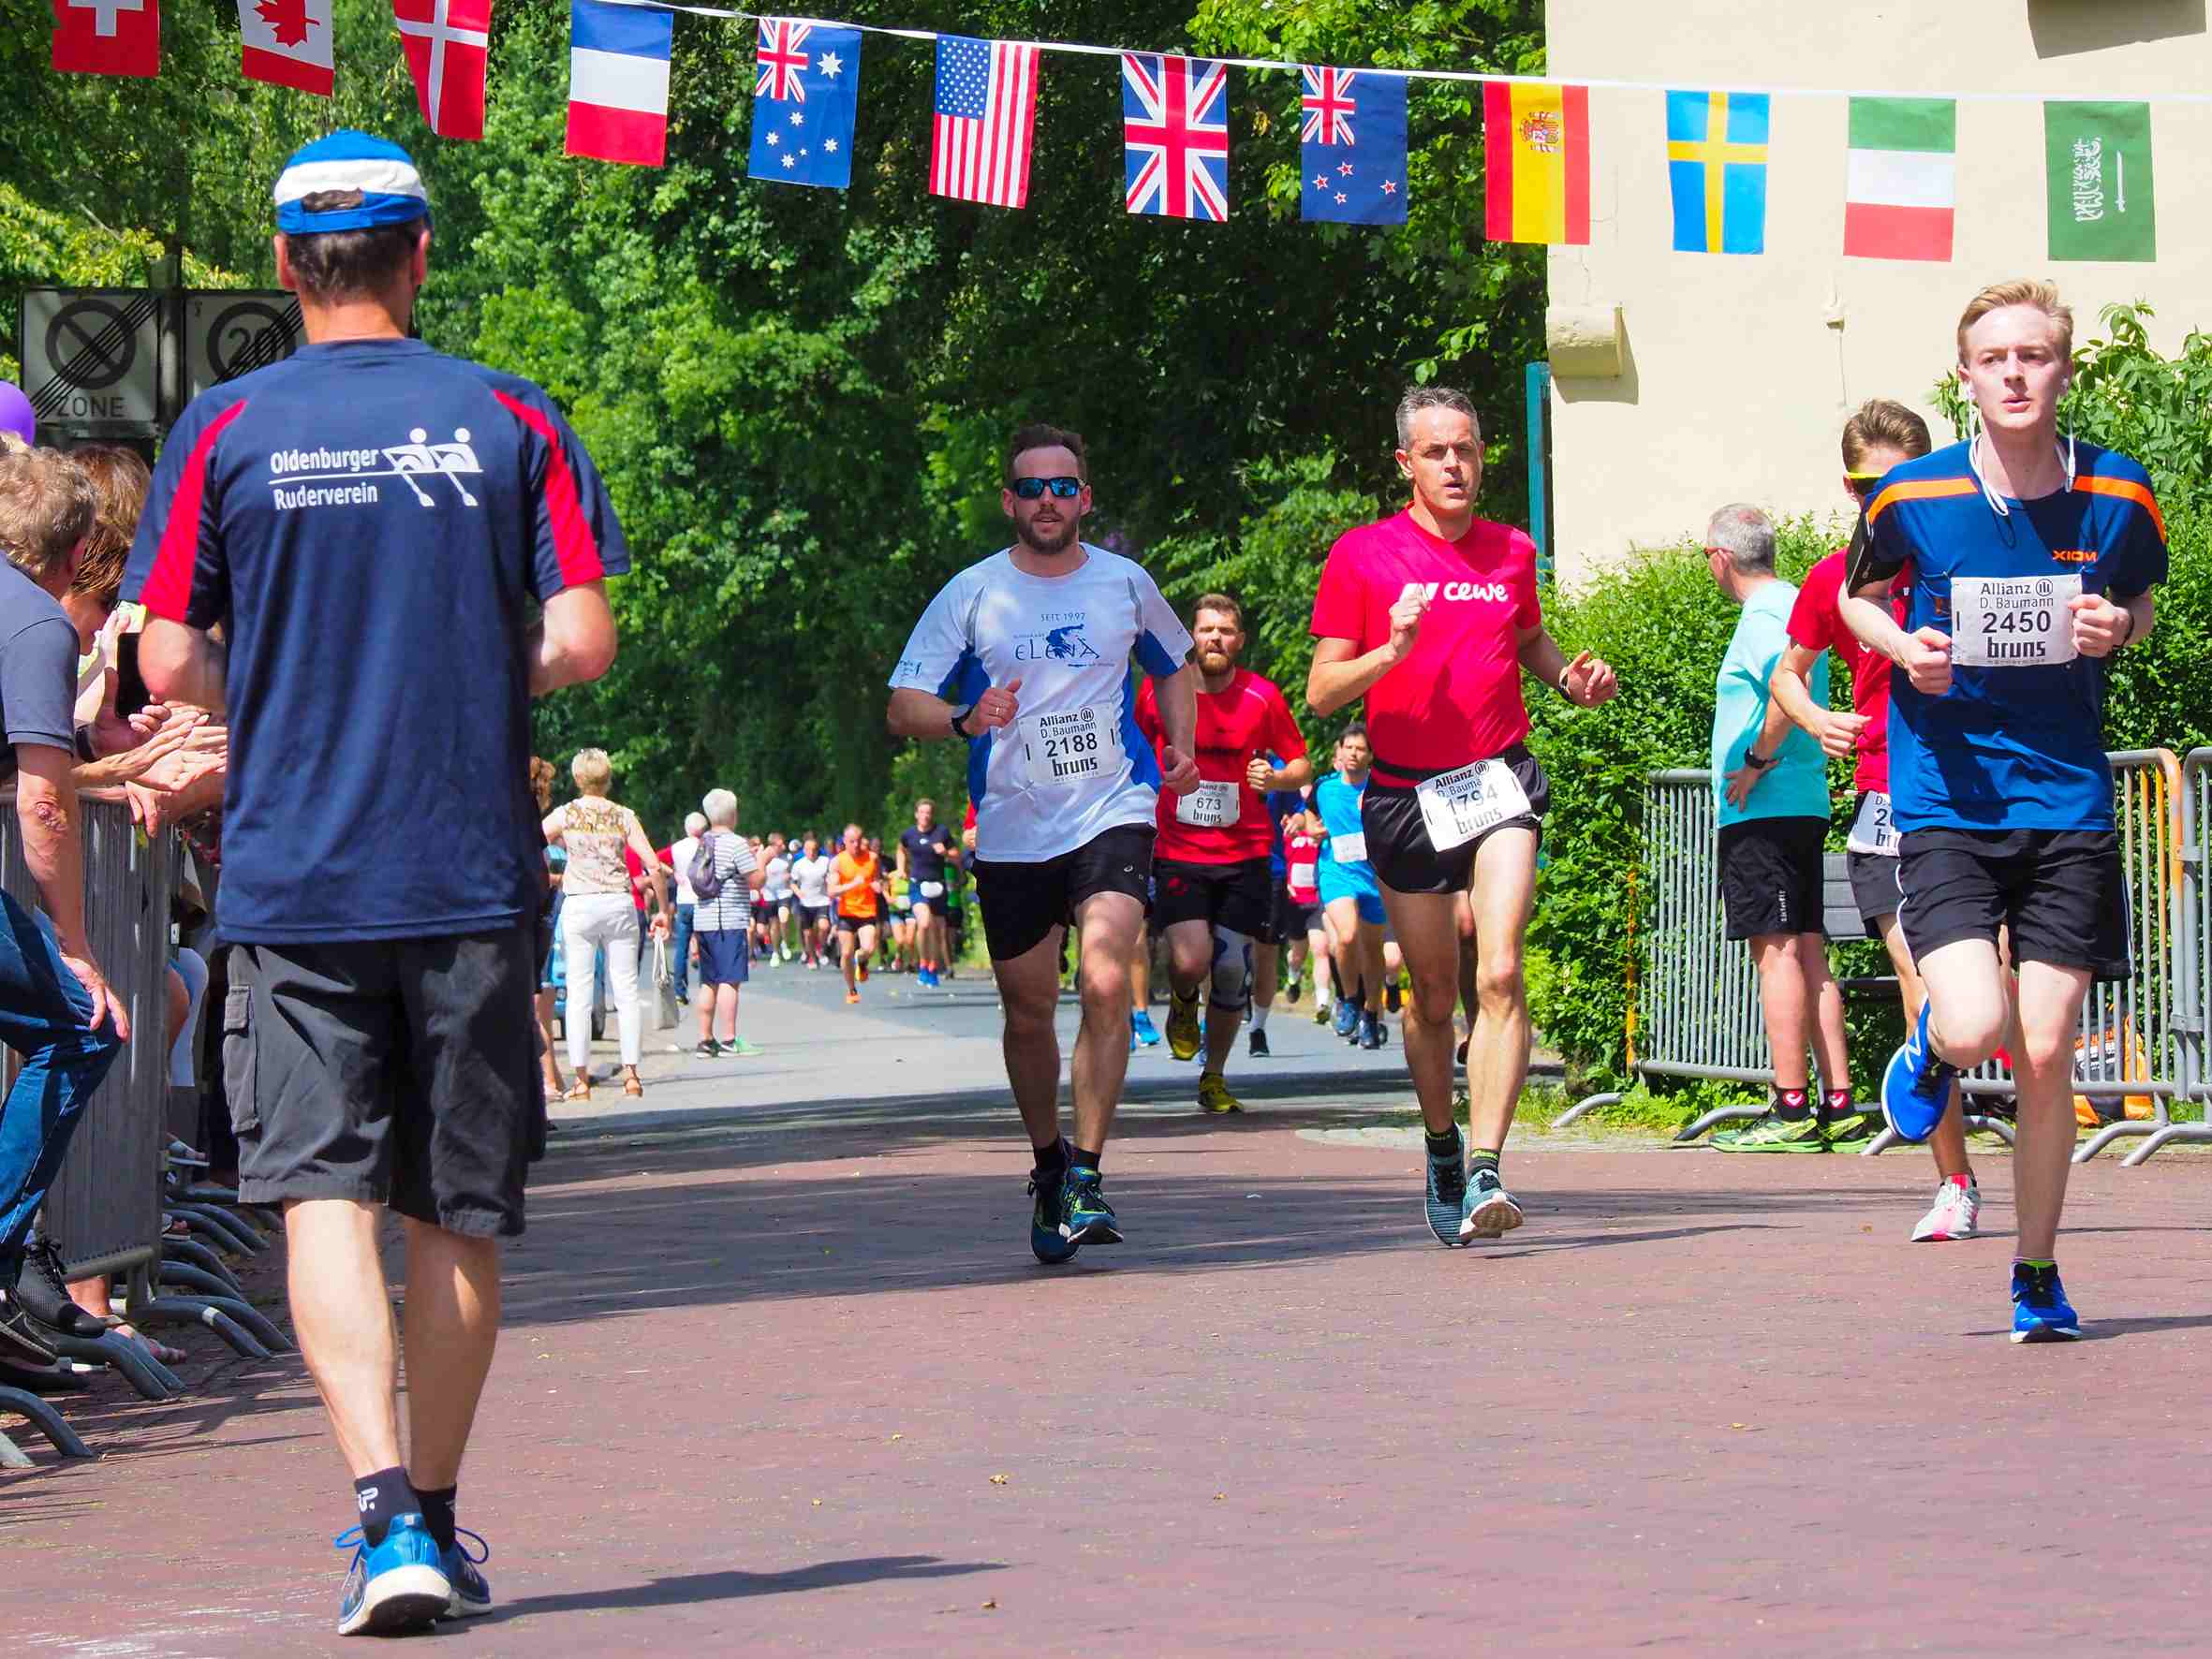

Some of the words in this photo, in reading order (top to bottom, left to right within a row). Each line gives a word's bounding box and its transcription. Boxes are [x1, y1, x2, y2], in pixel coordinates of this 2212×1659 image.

[57, 396, 125, 418] ZONE
[270, 447, 380, 474] Oldenburger
[273, 482, 378, 510] Ruderverein
[1443, 581, 1509, 602] cewe
[1981, 582, 2031, 595] Allianz
[1980, 597, 1992, 609] D.
[1997, 597, 2053, 609] Baumann
[1982, 610, 2051, 634] 2450
[1987, 637, 2045, 658] bruns
[1040, 713, 1079, 727] Allianz
[1040, 728, 1052, 739] D.
[1053, 722, 1097, 737] Baumann
[1045, 732, 1098, 758] 2188
[1052, 757, 1098, 777] bruns
[1435, 769, 1474, 789] Allianz
[1197, 797, 1221, 811] 673
[1445, 784, 1499, 815] 1794
[1192, 809, 1221, 825] bruns
[1455, 808, 1503, 835] bruns
